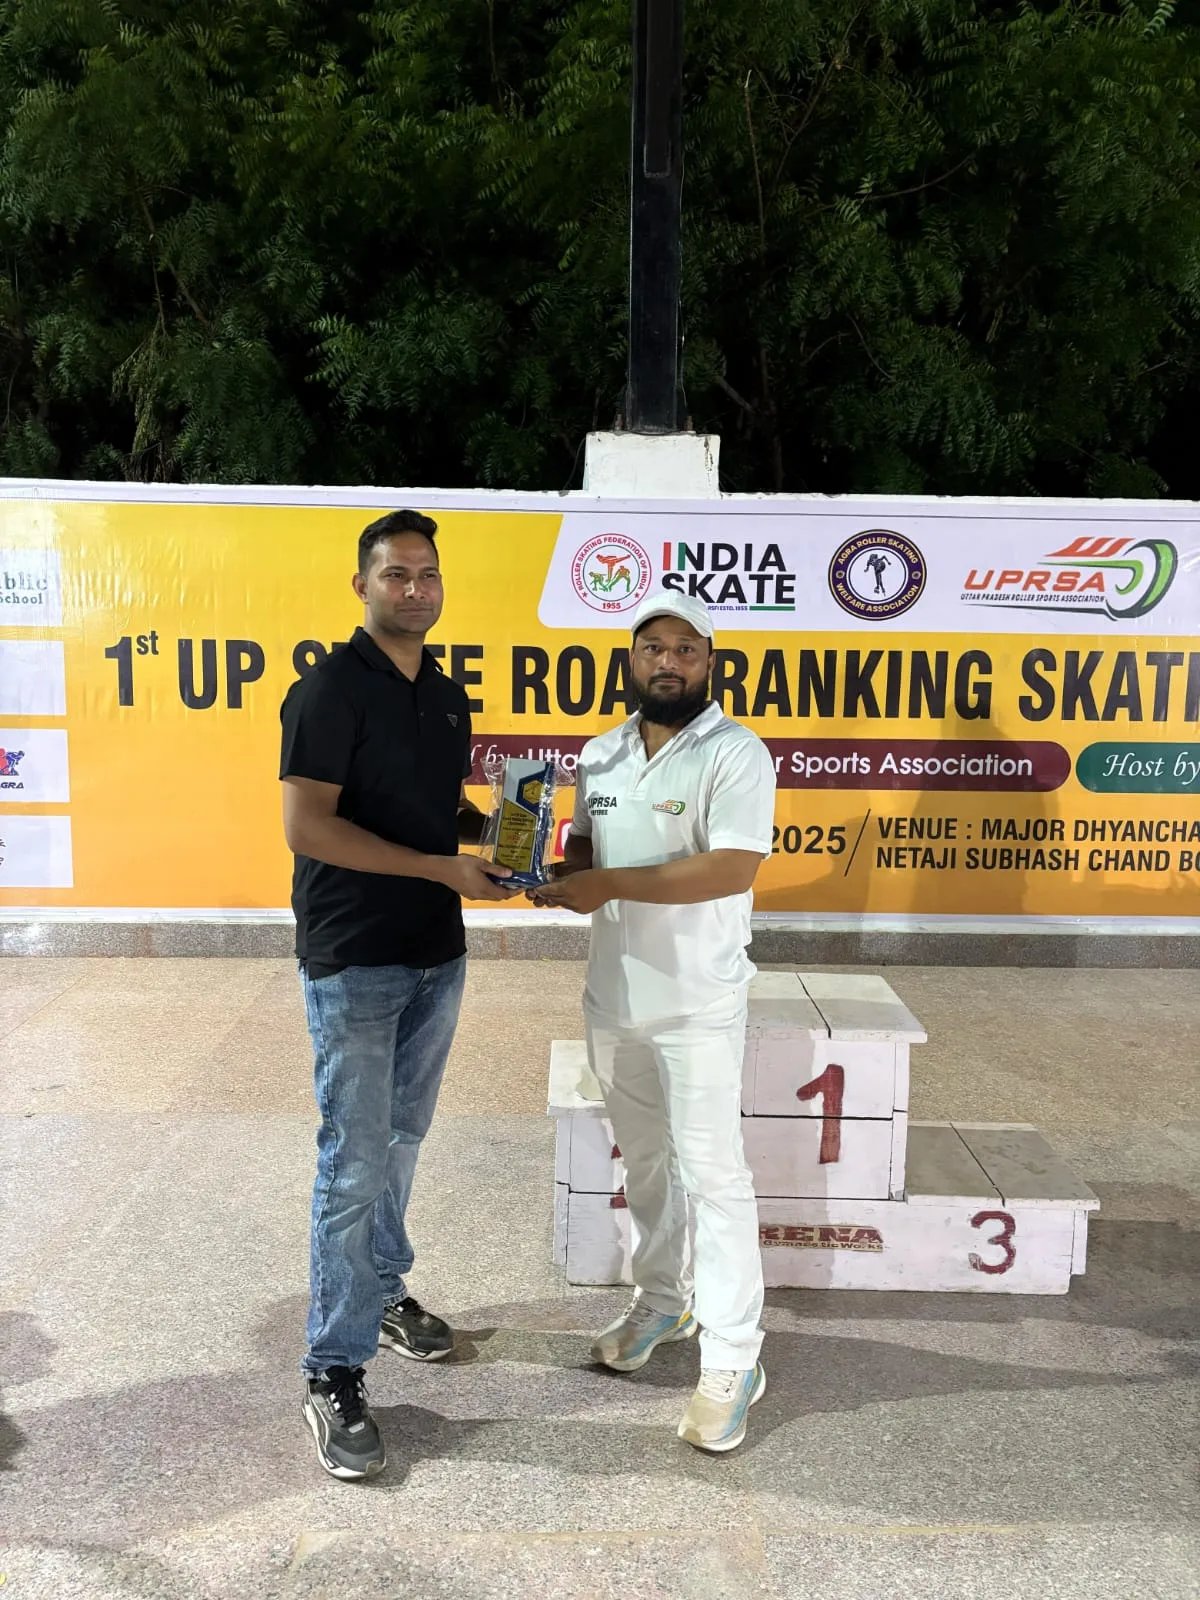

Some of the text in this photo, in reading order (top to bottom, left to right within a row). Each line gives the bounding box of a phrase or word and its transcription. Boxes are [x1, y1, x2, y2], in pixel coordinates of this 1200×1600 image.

[575, 537, 648, 590] ROLLER SKATING FEDERATION OF INDIA
[662, 542, 787, 572] INDIA
[838, 537, 918, 565] AGRA ROLLER SKATING
[0, 572, 47, 591] blic
[661, 573, 796, 604] SKATE
[964, 569, 1105, 592] UPRSA
[602, 602, 621, 610] 1955
[836, 583, 919, 612] WELFARE ASSOCIATION
[981, 593, 1010, 601] PRADESH
[1036, 594, 1060, 602] SPORTS
[1061, 595, 1105, 603] ASSOCIATION
[104, 630, 159, 706] 1st
[177, 638, 265, 710] UP
[512, 645, 640, 716] ROA
[711, 648, 992, 721] RANKING
[791, 751, 871, 778] Sports
[878, 752, 1033, 776] Association
[1102, 751, 1200, 785] Host by
[771, 825, 846, 855] 2025
[878, 817, 1200, 842] VENUE : MAJOR DHYANCHA
[876, 846, 956, 869] NETAJI
[965, 847, 1080, 871] SUBHASH
[1088, 848, 1170, 872] CHAND
[796, 1063, 845, 1164] 1
[841, 1242, 884, 1250] Woks
[968, 1210, 1017, 1275] 3
